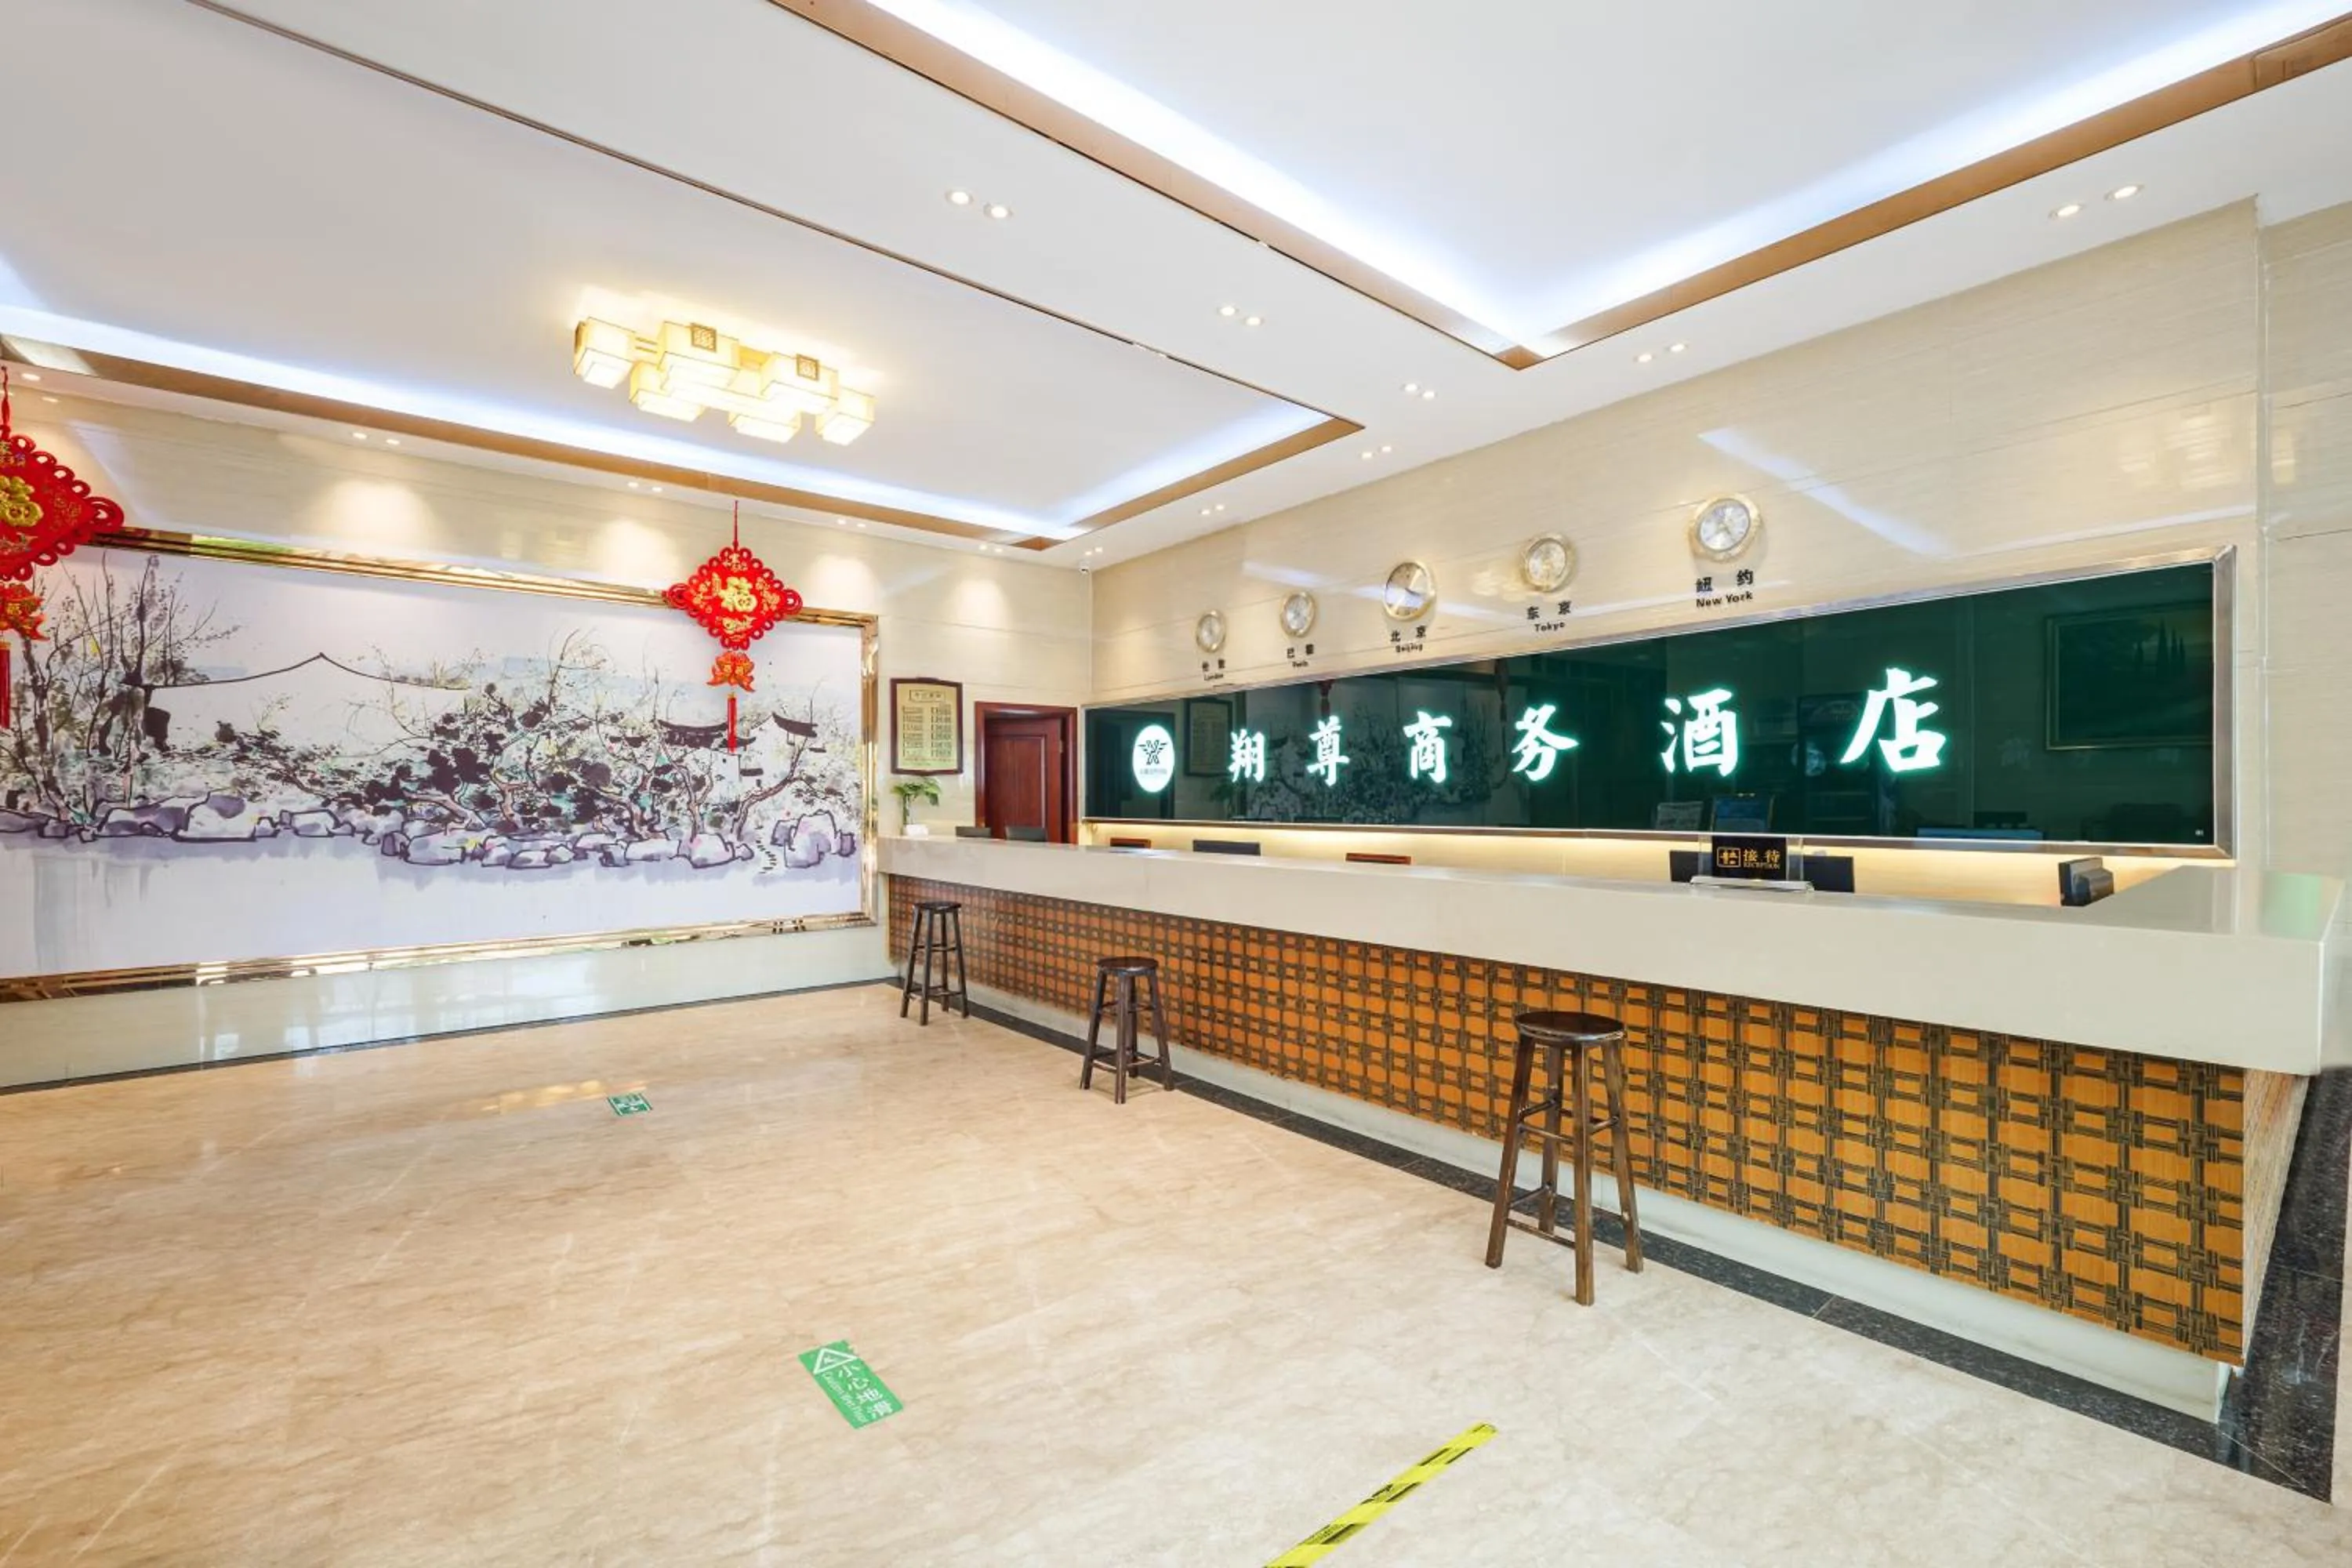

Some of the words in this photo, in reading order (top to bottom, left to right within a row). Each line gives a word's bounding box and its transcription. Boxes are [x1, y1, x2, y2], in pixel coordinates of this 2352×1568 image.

[1695, 568, 1754, 593] 纽约
[719, 576, 757, 612] 福
[1696, 597, 1722, 608] New
[1726, 590, 1753, 604] York
[1527, 601, 1571, 619] 东京
[1390, 626, 1426, 642] 北京
[1534, 621, 1566, 633] Tokyo
[1228, 667, 1947, 786] 翔尊商务酒店
[1743, 849, 1780, 863] 接待
